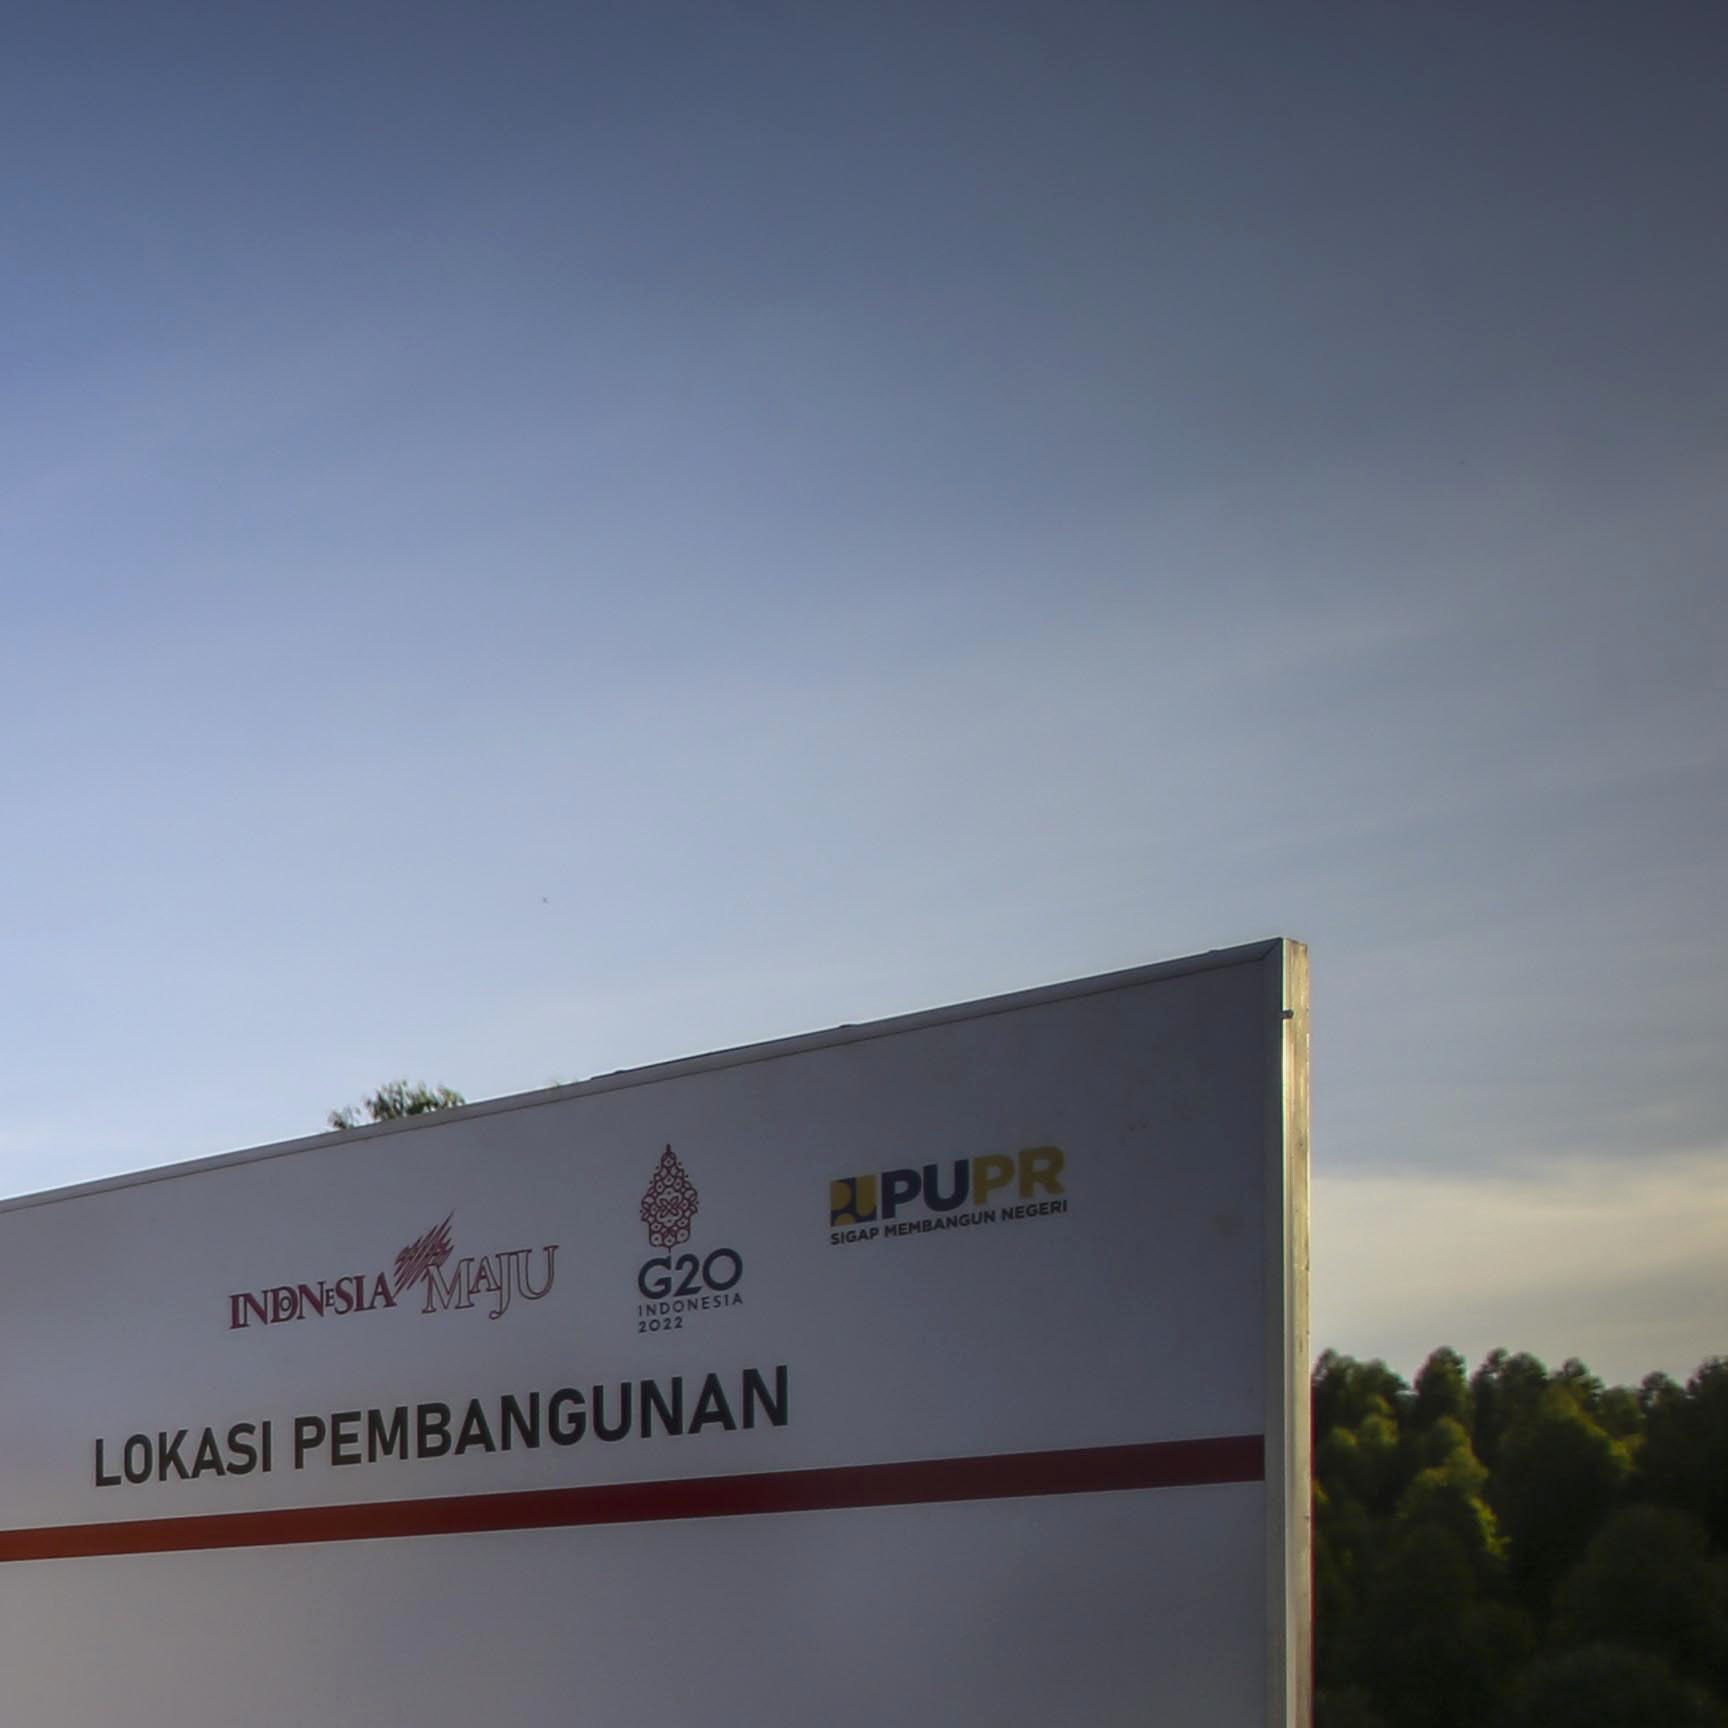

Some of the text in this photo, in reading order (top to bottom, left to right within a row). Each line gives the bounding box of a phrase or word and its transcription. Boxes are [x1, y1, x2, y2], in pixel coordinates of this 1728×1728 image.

[881, 1146, 1065, 1219] PUPR
[830, 1200, 1067, 1245] SIGAP MEMBANGUN NEGERI
[421, 1245, 559, 1320] MAJU
[638, 1248, 743, 1299] G20
[638, 1293, 743, 1317] INDONESIA
[638, 1316, 683, 1333] 2022
[94, 1364, 789, 1488] LOKASI PEMBANGUNAN
